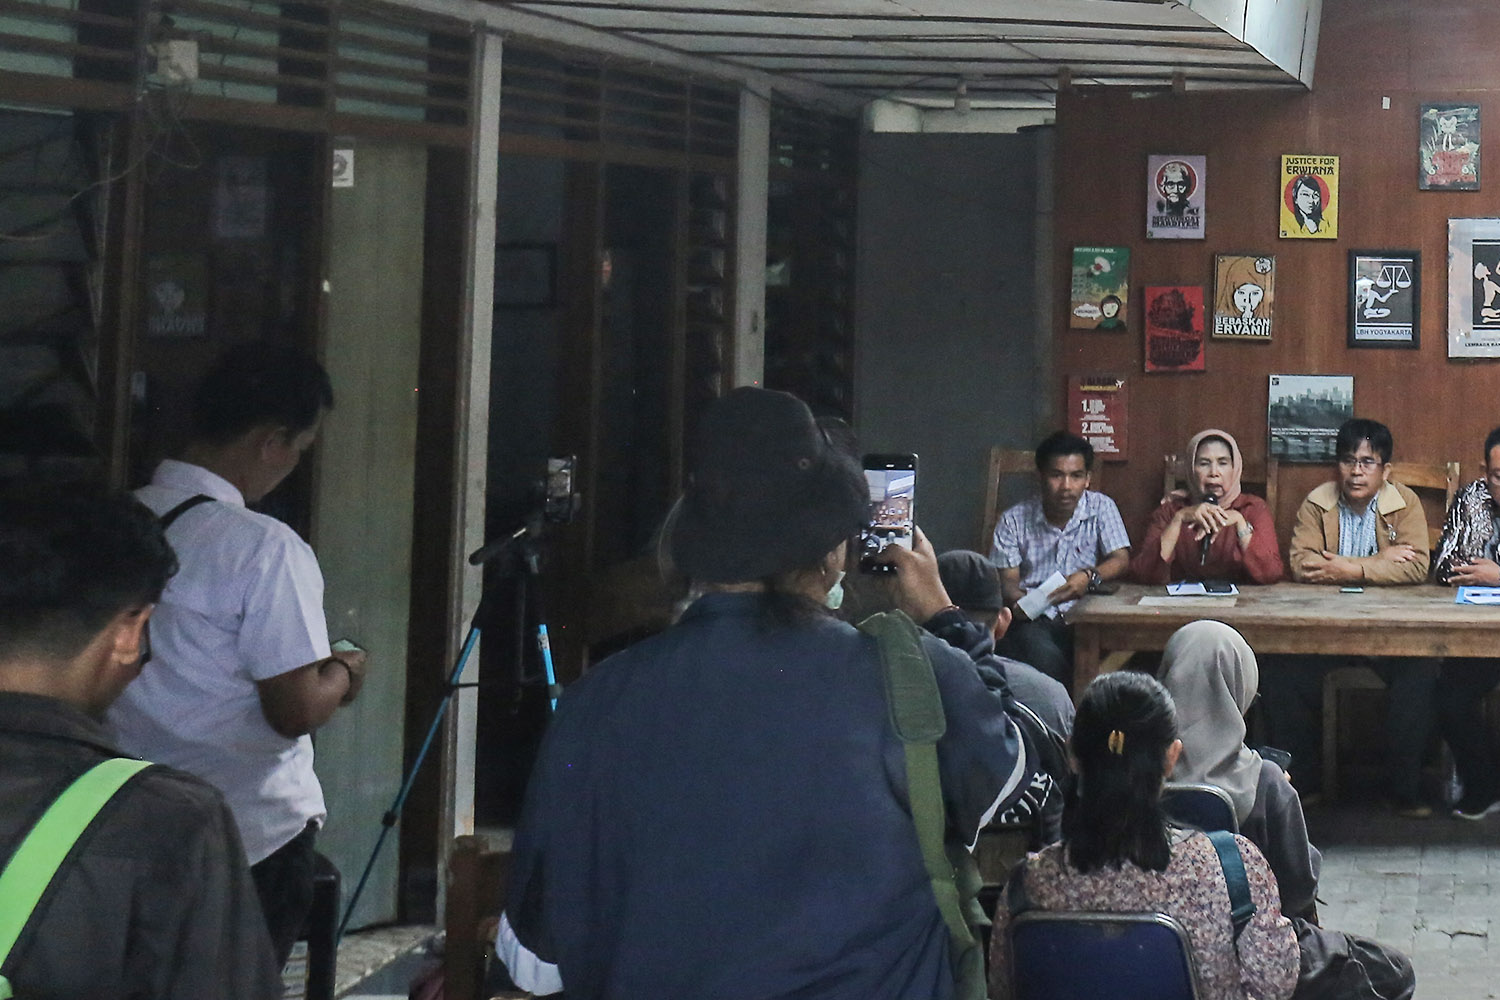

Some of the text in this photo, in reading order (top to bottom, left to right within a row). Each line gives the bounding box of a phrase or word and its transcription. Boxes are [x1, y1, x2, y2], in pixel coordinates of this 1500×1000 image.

[1286, 157, 1317, 165] JUSTICE
[1286, 166, 1334, 175] ERWIANA
[1215, 316, 1270, 326] BEBASKAN
[1214, 324, 1270, 336] ERVANI!
